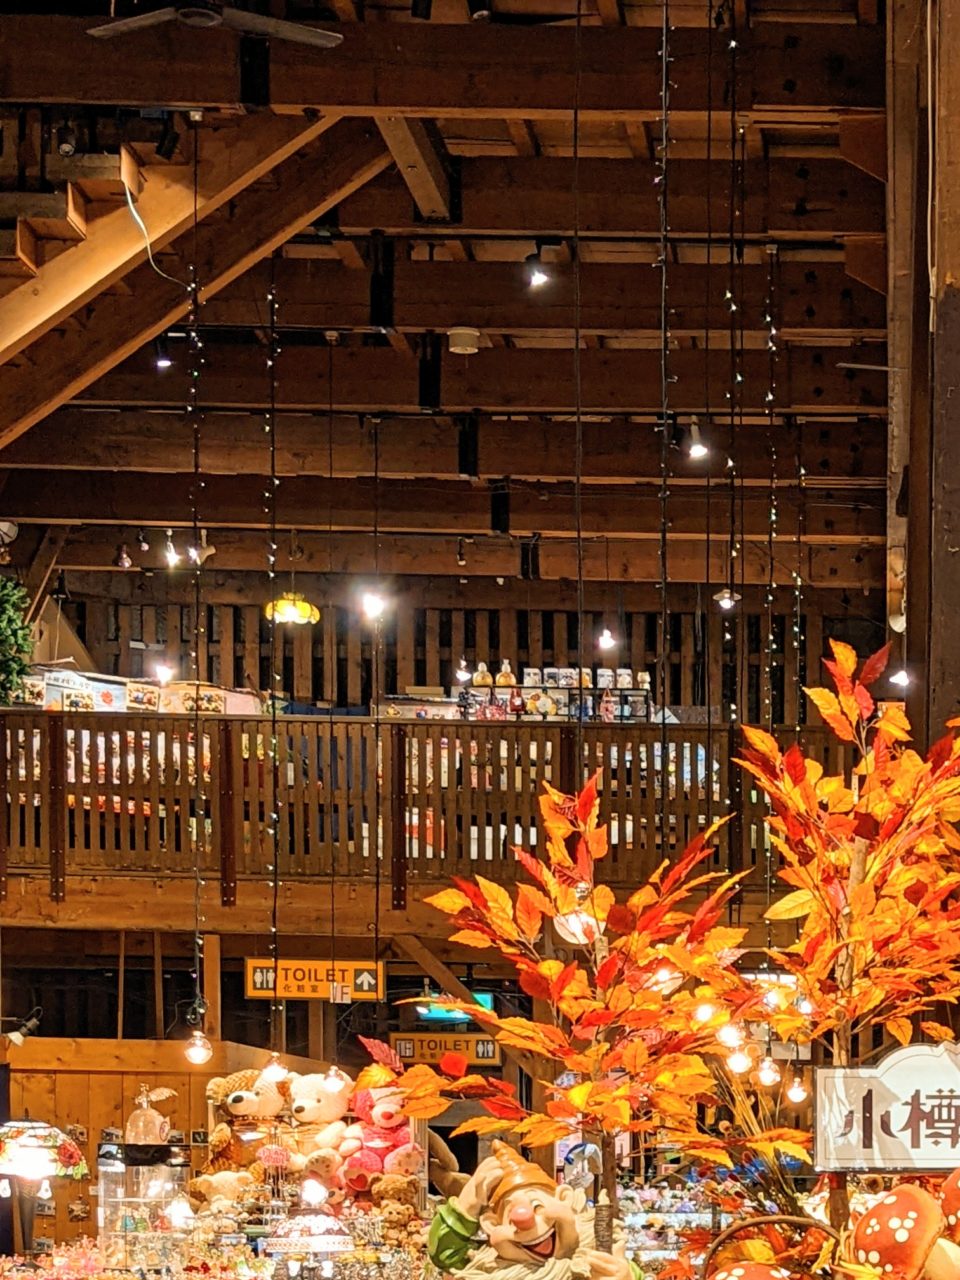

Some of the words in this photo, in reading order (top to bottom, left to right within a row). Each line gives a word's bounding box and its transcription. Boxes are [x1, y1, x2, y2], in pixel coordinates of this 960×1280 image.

[281, 967, 349, 982] TOILET
[283, 984, 319, 993] 化粧室
[419, 1039, 472, 1051] TOILET
